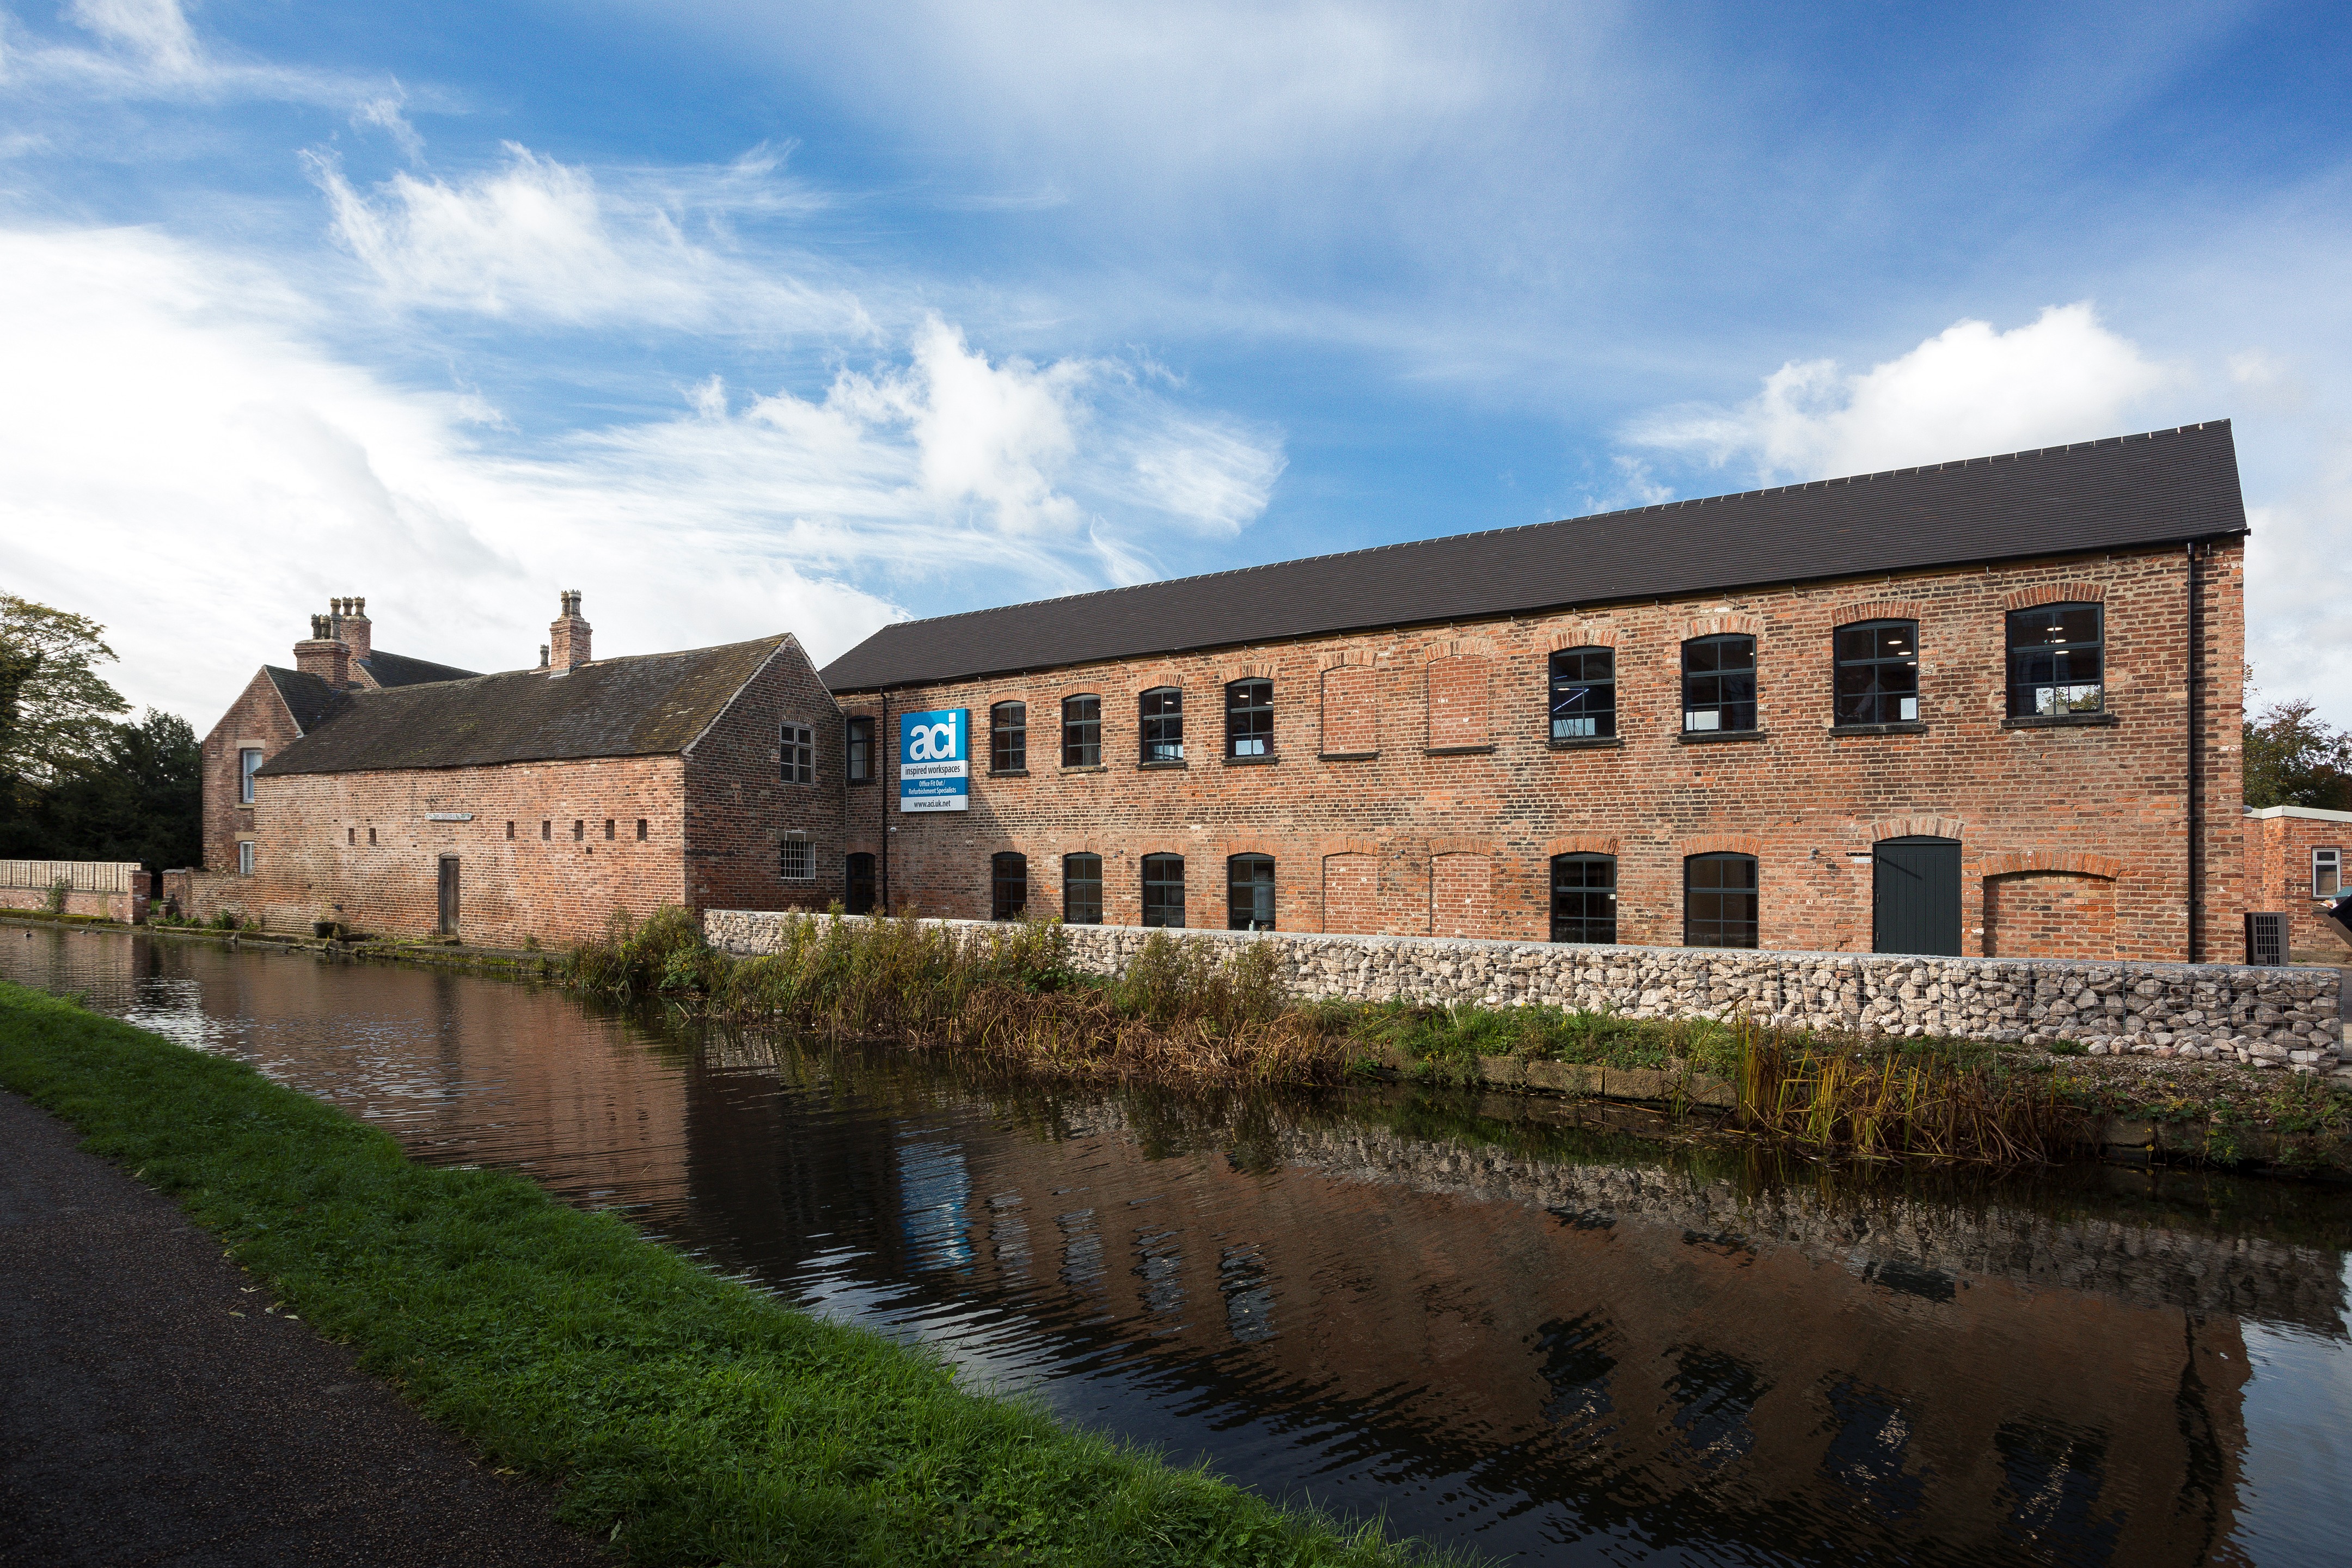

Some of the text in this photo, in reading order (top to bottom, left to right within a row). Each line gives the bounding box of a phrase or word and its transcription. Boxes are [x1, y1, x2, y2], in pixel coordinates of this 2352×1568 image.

[910, 712, 956, 761] aci
[905, 764, 960, 777] inspired workspaces
[936, 787, 957, 795] Specialists
[914, 799, 951, 807] www.aci.uk.net
